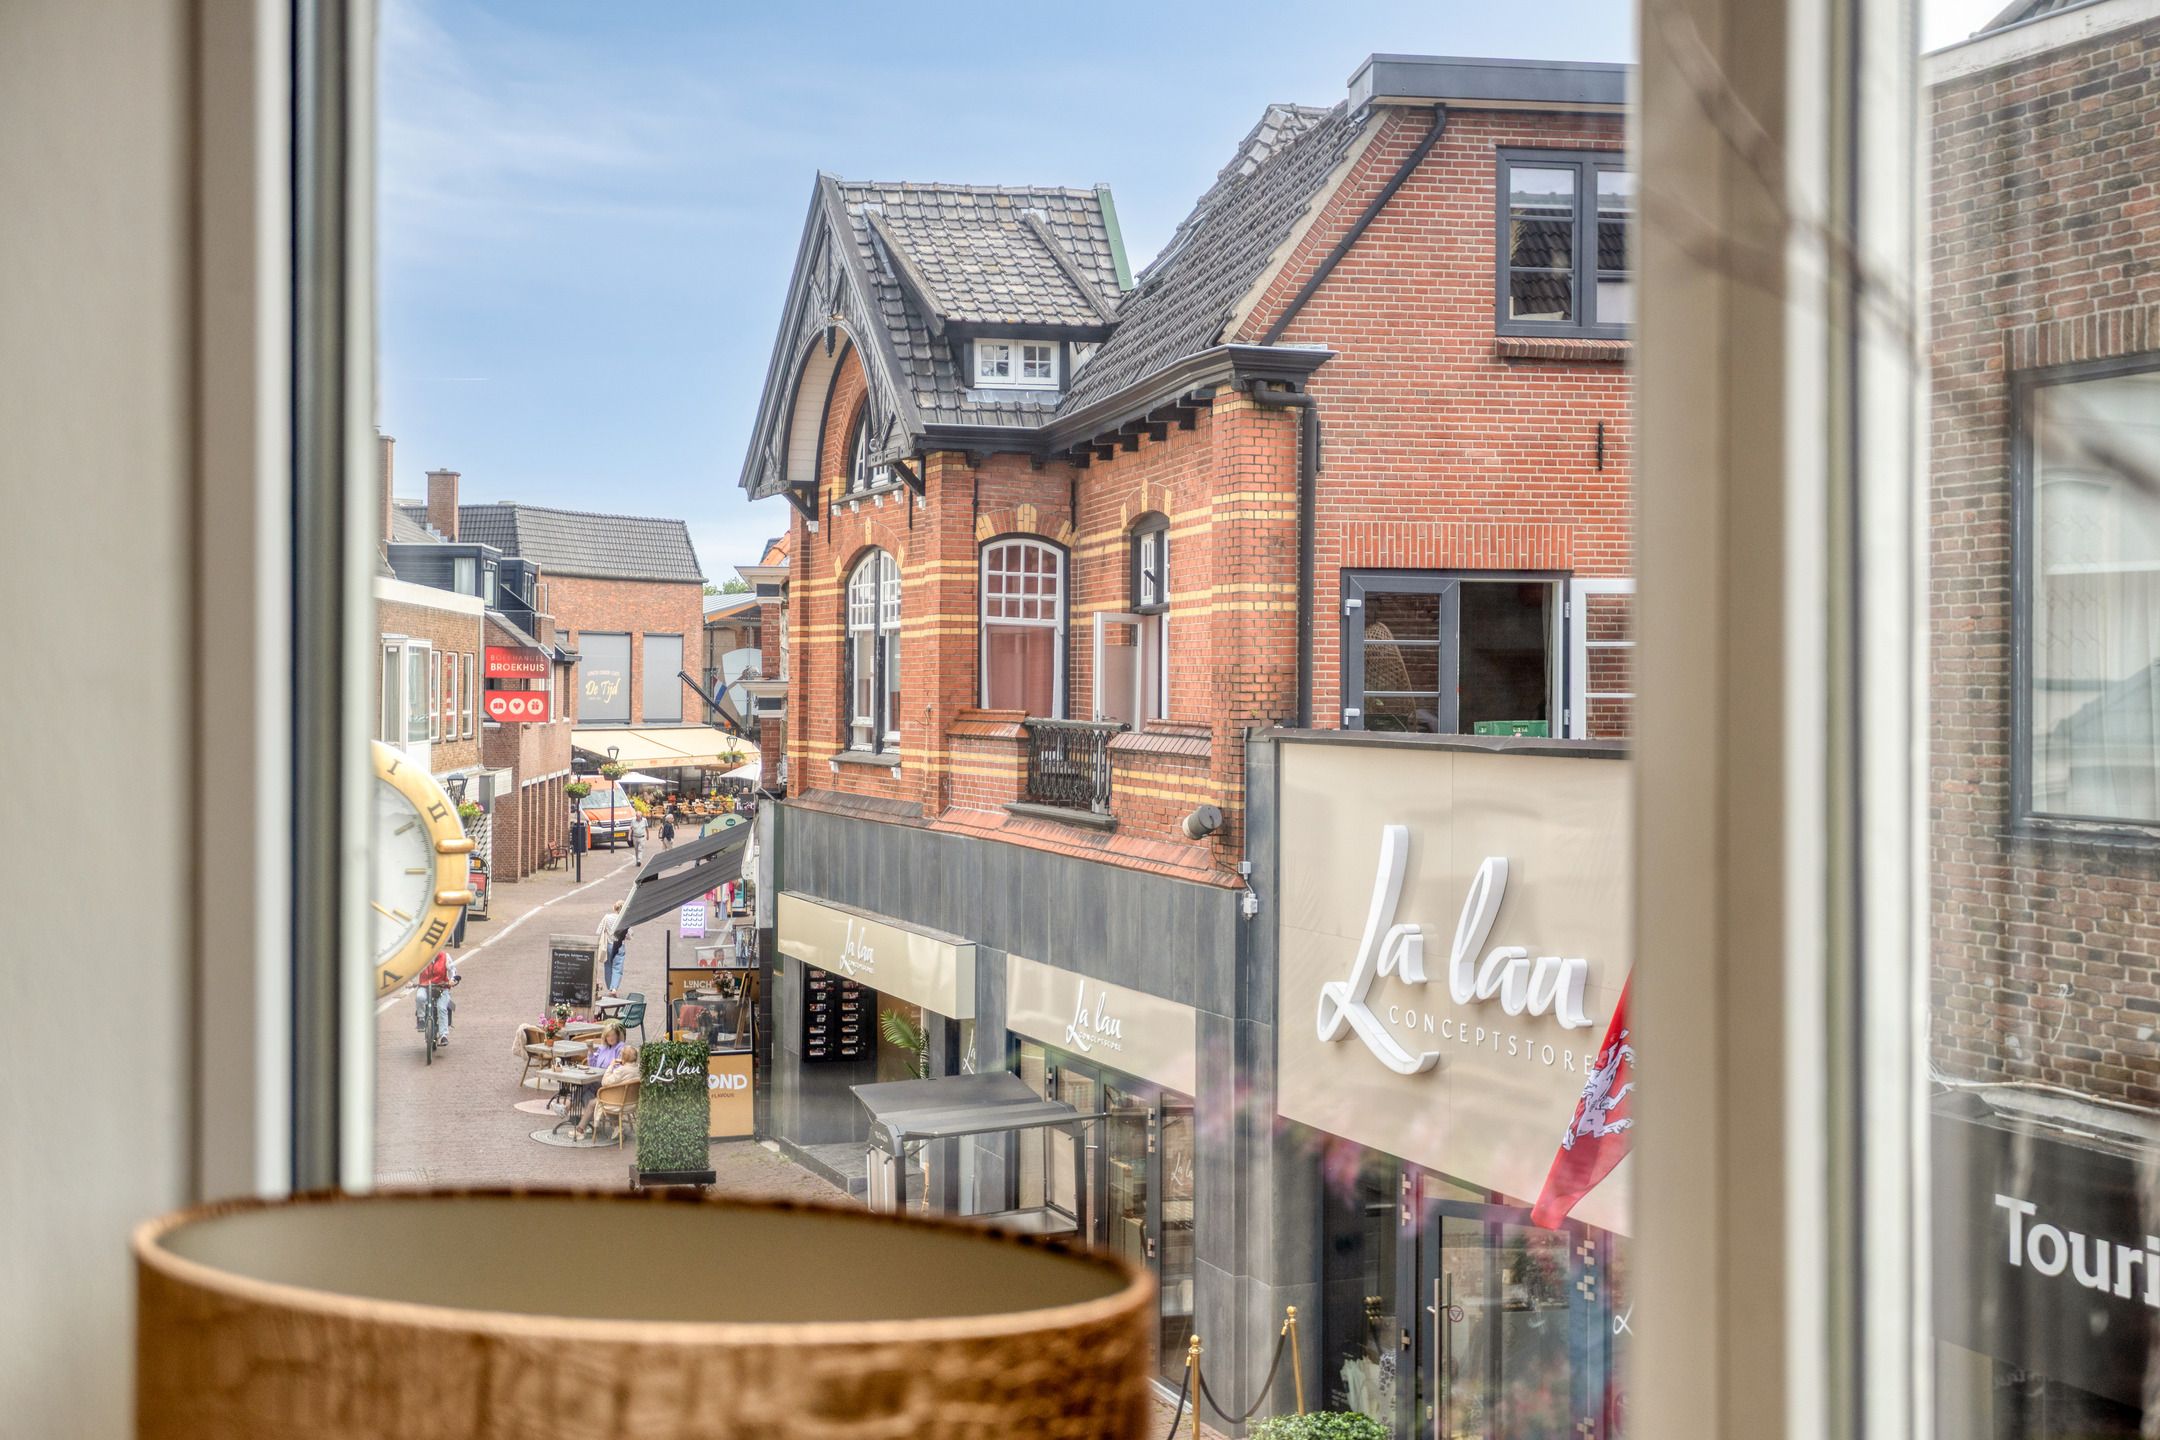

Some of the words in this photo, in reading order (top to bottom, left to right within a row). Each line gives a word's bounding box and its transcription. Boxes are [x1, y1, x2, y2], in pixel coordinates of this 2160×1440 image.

[490, 662, 545, 672] BROEKHUIS
[600, 677, 621, 704] Tijd
[1316, 824, 1440, 1075] La
[1066, 979, 1092, 1052] La
[1388, 1005, 1597, 1077] CONCEPTSTORE
[650, 1053, 674, 1083] La
[1994, 1193, 2160, 1309] Touri
